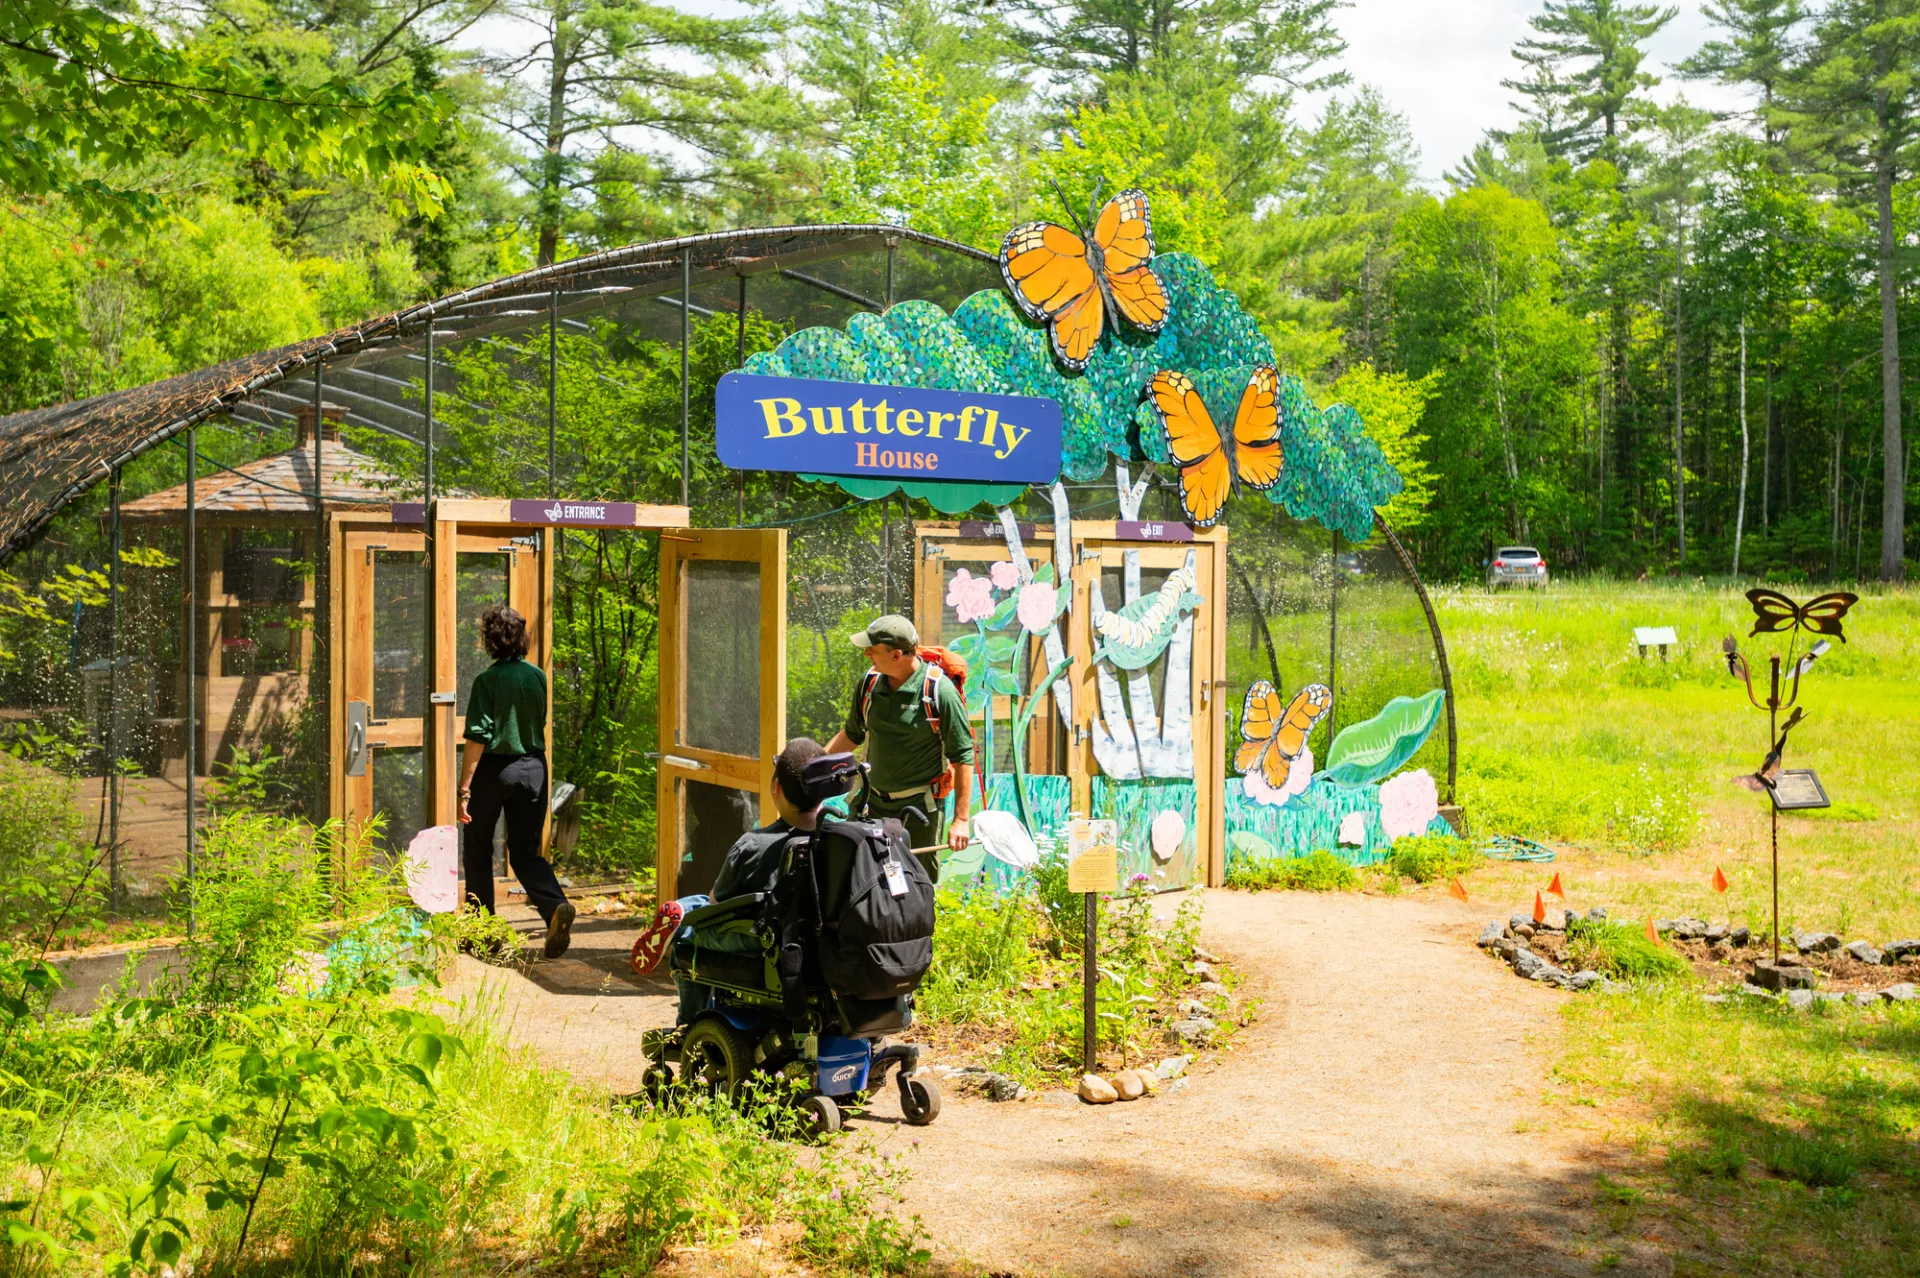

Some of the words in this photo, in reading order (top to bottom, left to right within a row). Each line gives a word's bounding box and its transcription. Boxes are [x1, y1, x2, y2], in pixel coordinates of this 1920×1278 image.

[753, 397, 1031, 460] Butterfly
[855, 442, 939, 470] House
[564, 505, 605, 520] ENTRANCE
[1152, 524, 1164, 536] EXIT
